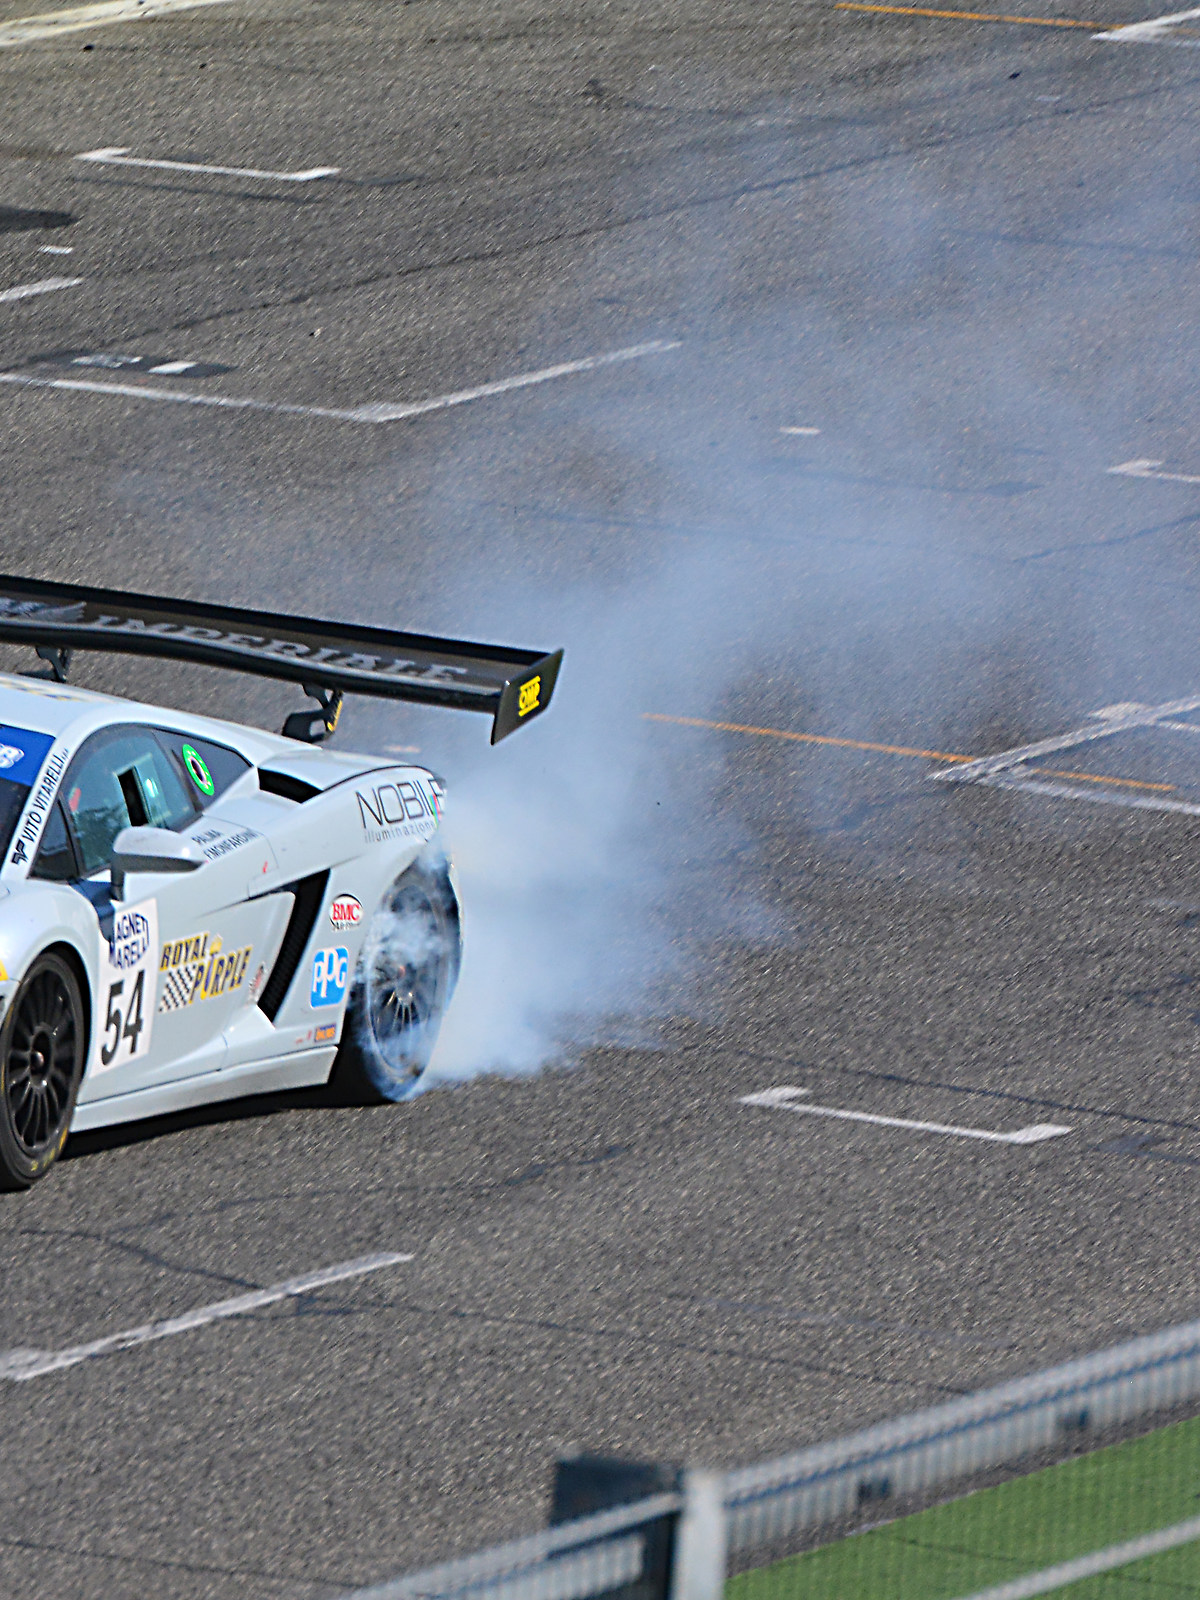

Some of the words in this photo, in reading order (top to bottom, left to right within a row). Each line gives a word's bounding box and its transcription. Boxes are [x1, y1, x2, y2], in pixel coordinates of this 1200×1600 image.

[22, 811, 42, 843] VITO
[33, 754, 64, 811] VITARELLI
[332, 903, 360, 921] BMC
[159, 932, 209, 971] ROYAL
[188, 944, 254, 1004] PURPLE
[313, 949, 348, 998] PPG
[102, 970, 145, 1066] 54
